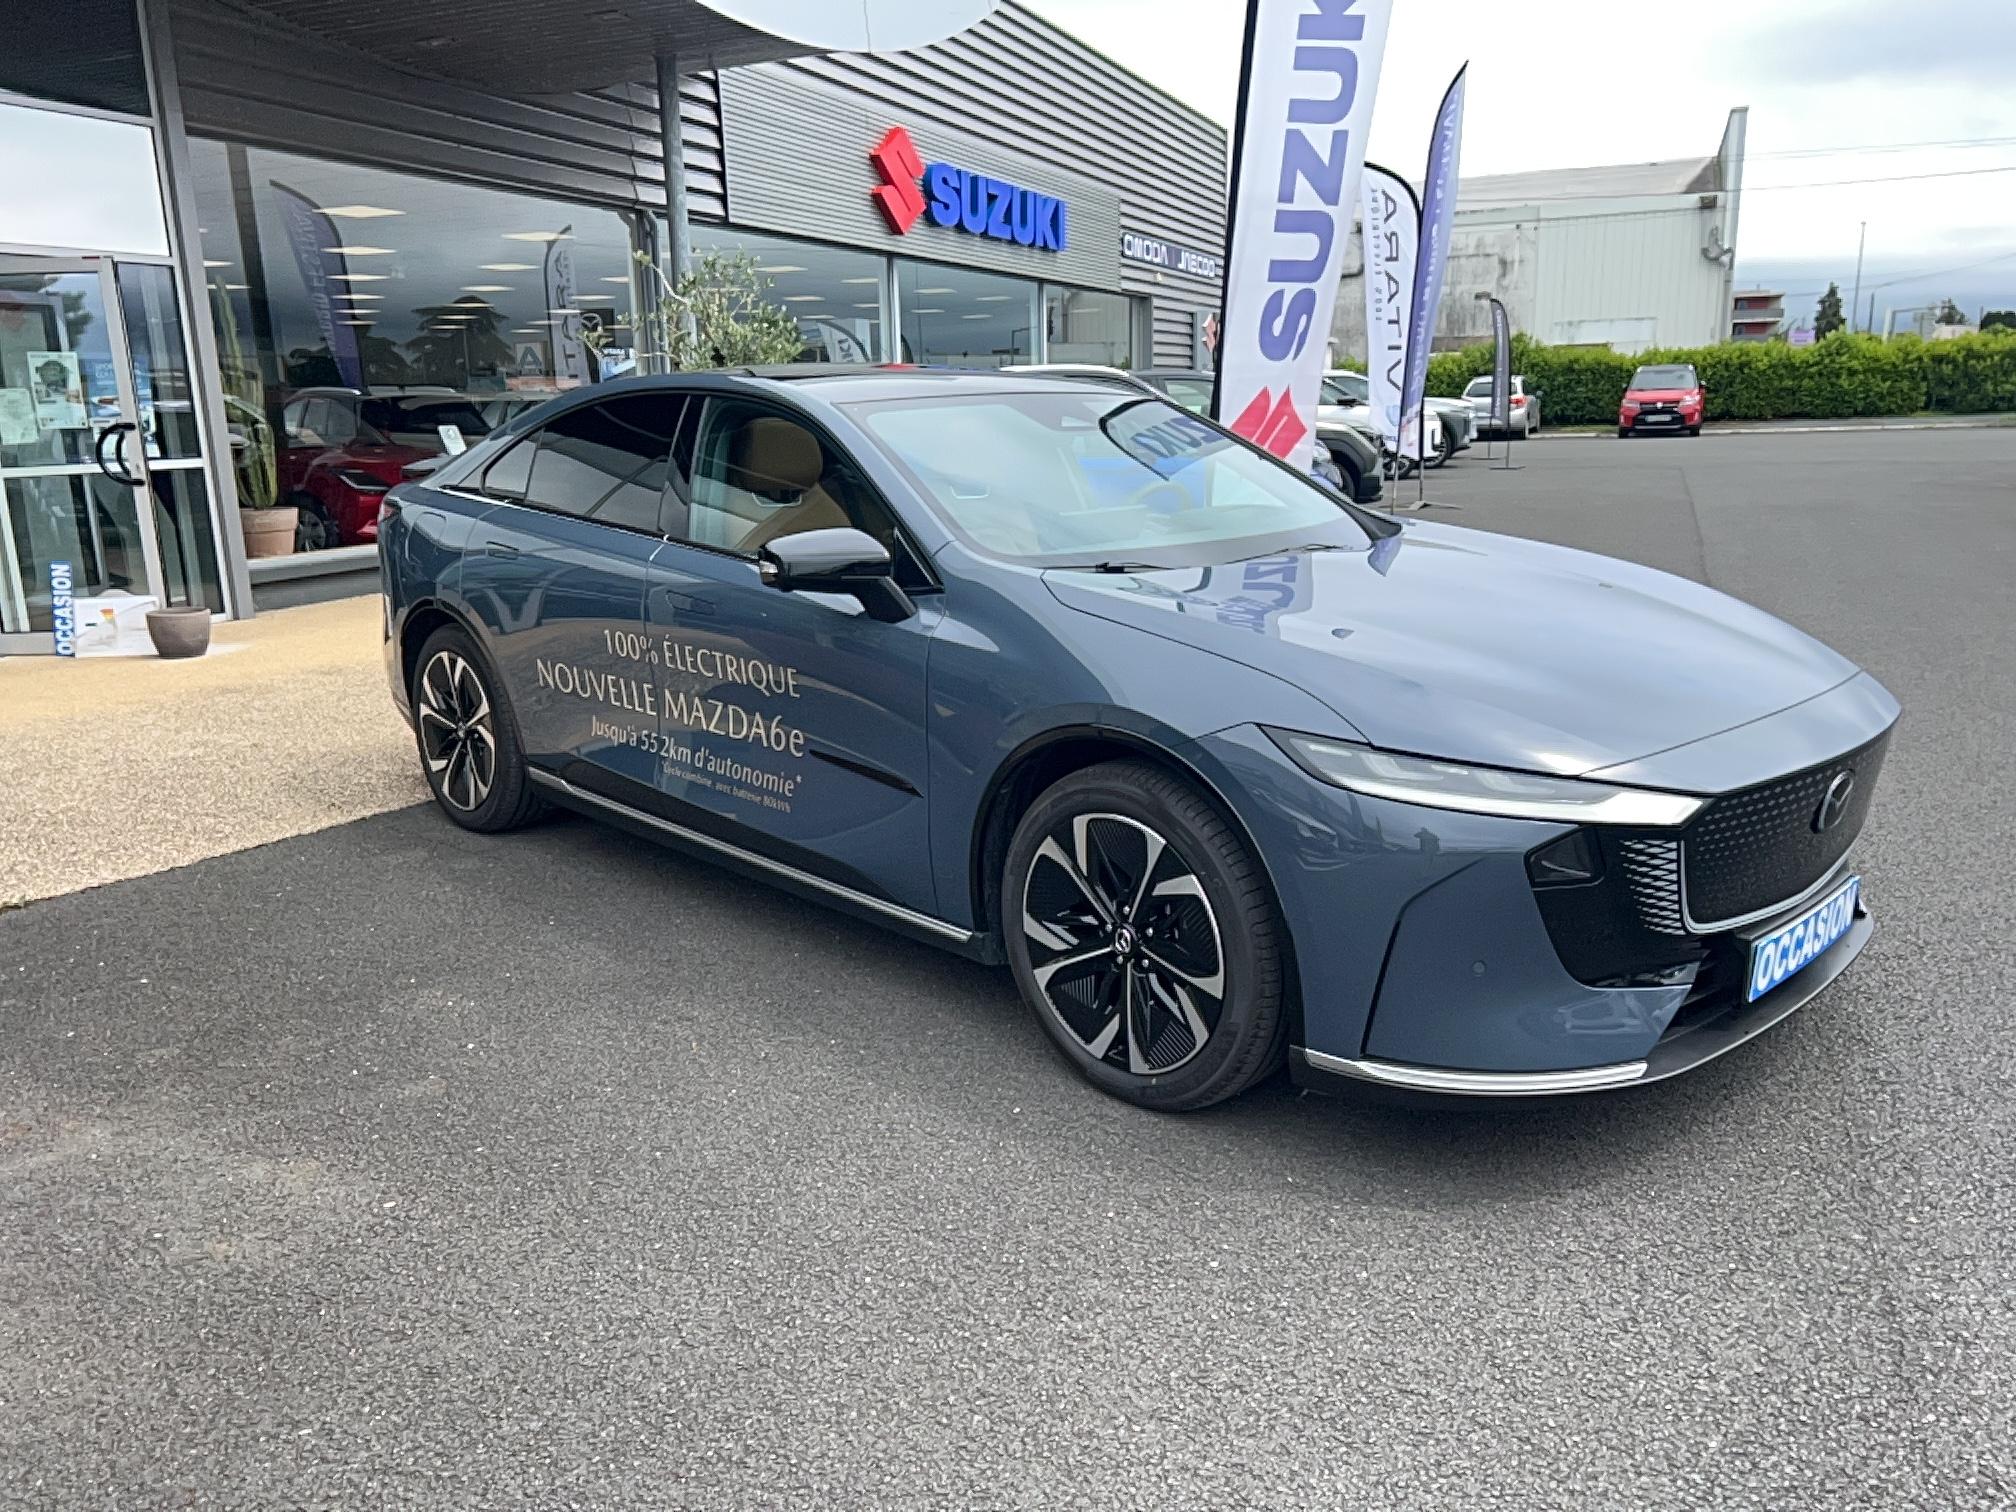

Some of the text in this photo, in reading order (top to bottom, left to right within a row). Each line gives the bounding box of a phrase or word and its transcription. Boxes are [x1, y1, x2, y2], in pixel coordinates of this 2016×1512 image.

[924, 162, 1067, 252] SUZUKI
[1123, 233, 1215, 277] OMODA JAECOO
[50, 563, 75, 656] OCCASION
[536, 658, 806, 758] NOUVELLE MAZDA6e
[603, 629, 802, 699] 100% ÉLECTRIQUE
[591, 715, 638, 748] Jusqu'à
[1756, 882, 1859, 992] OCCASION
